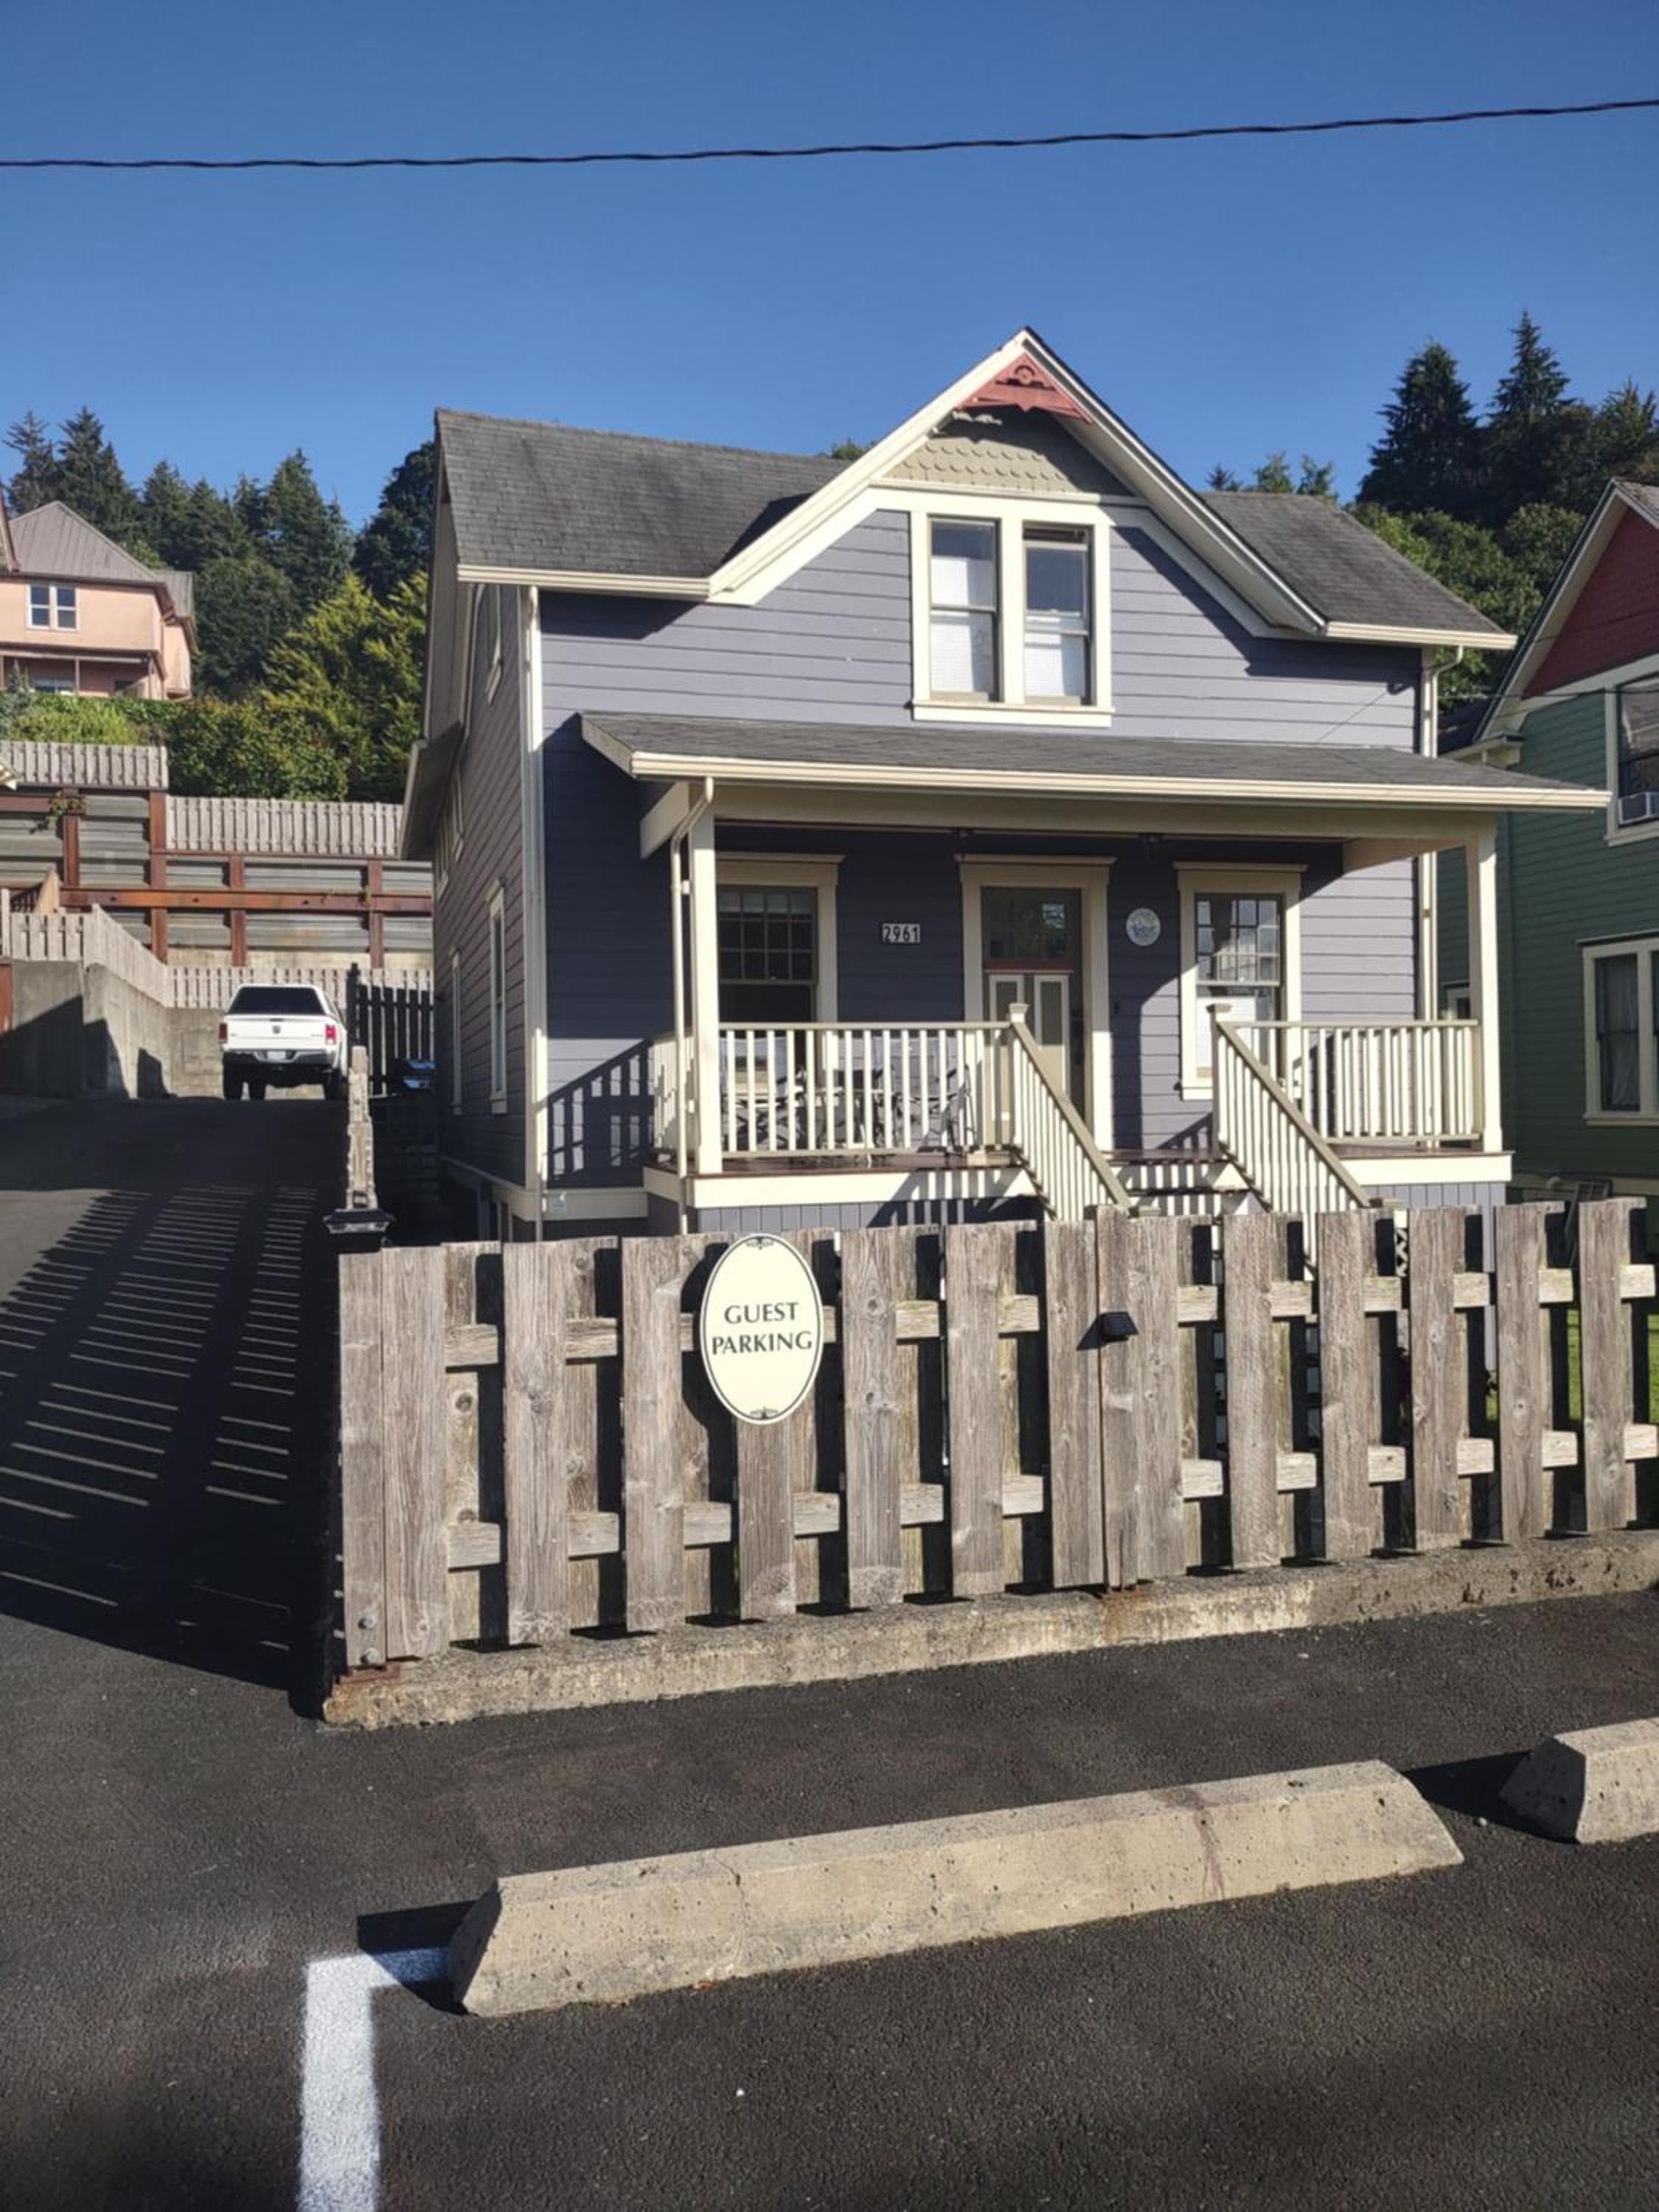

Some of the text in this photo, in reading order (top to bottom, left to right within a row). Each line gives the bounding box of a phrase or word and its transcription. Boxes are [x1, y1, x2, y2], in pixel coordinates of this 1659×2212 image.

[884, 925, 918, 943] 2961
[724, 1302, 799, 1324] GUEST
[712, 1331, 812, 1354] PARKING
